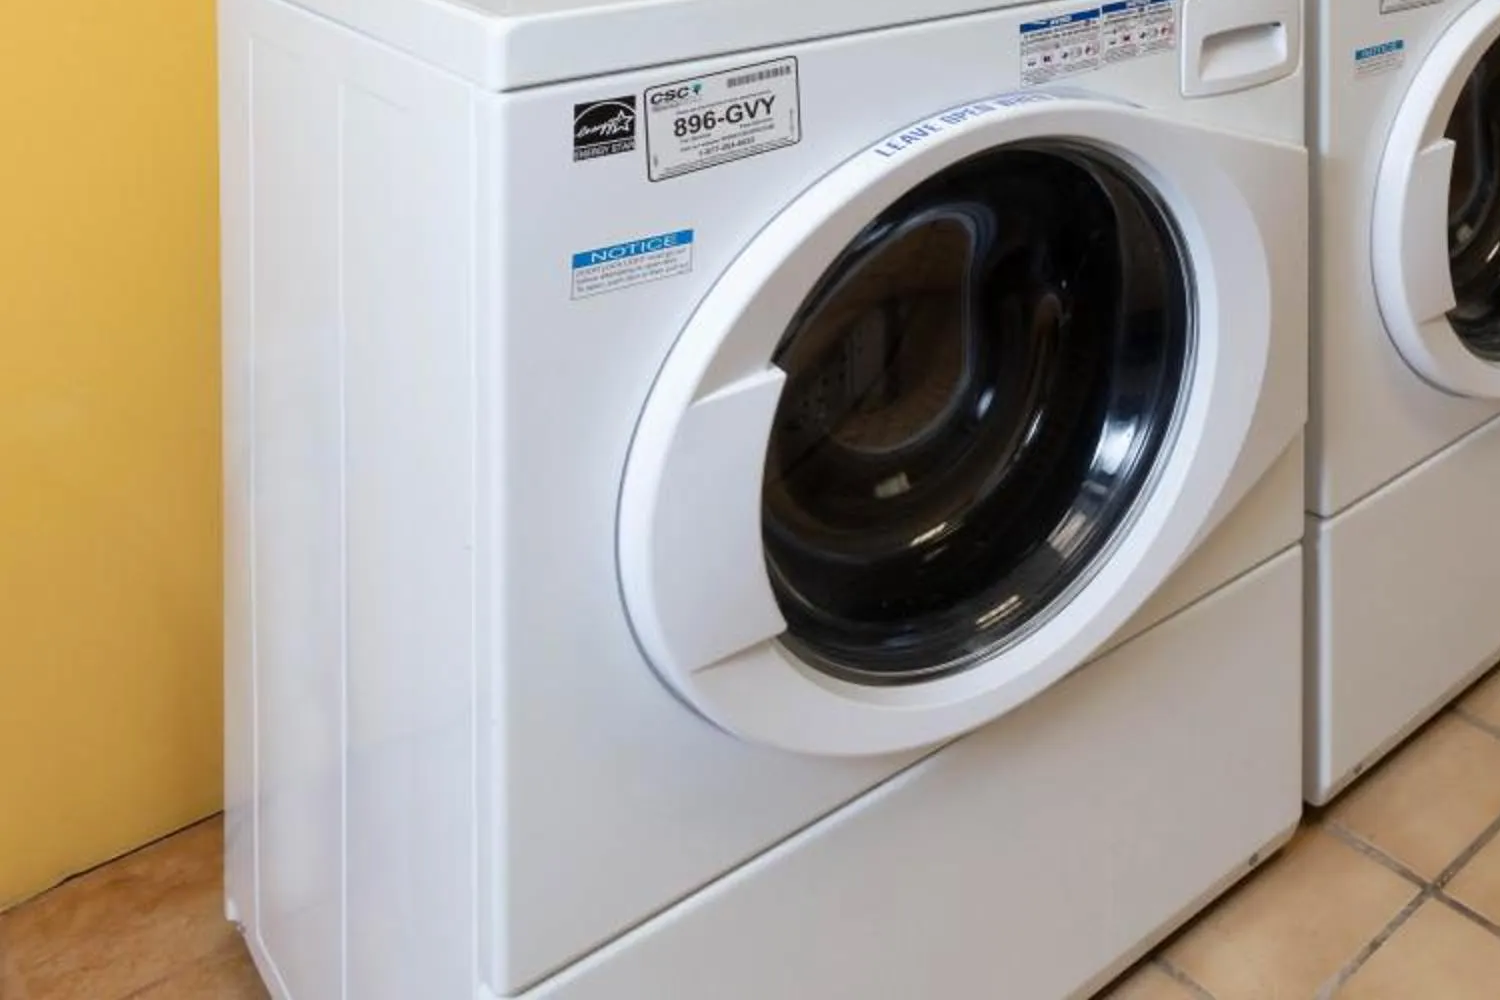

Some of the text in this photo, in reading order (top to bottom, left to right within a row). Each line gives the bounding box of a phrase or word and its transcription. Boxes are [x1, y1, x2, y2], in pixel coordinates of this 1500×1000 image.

[651, 87, 689, 105] CSC
[673, 95, 775, 137] 896-GVY
[875, 104, 997, 157] LEAVE OPEN
[591, 236, 675, 262] NOTICE
